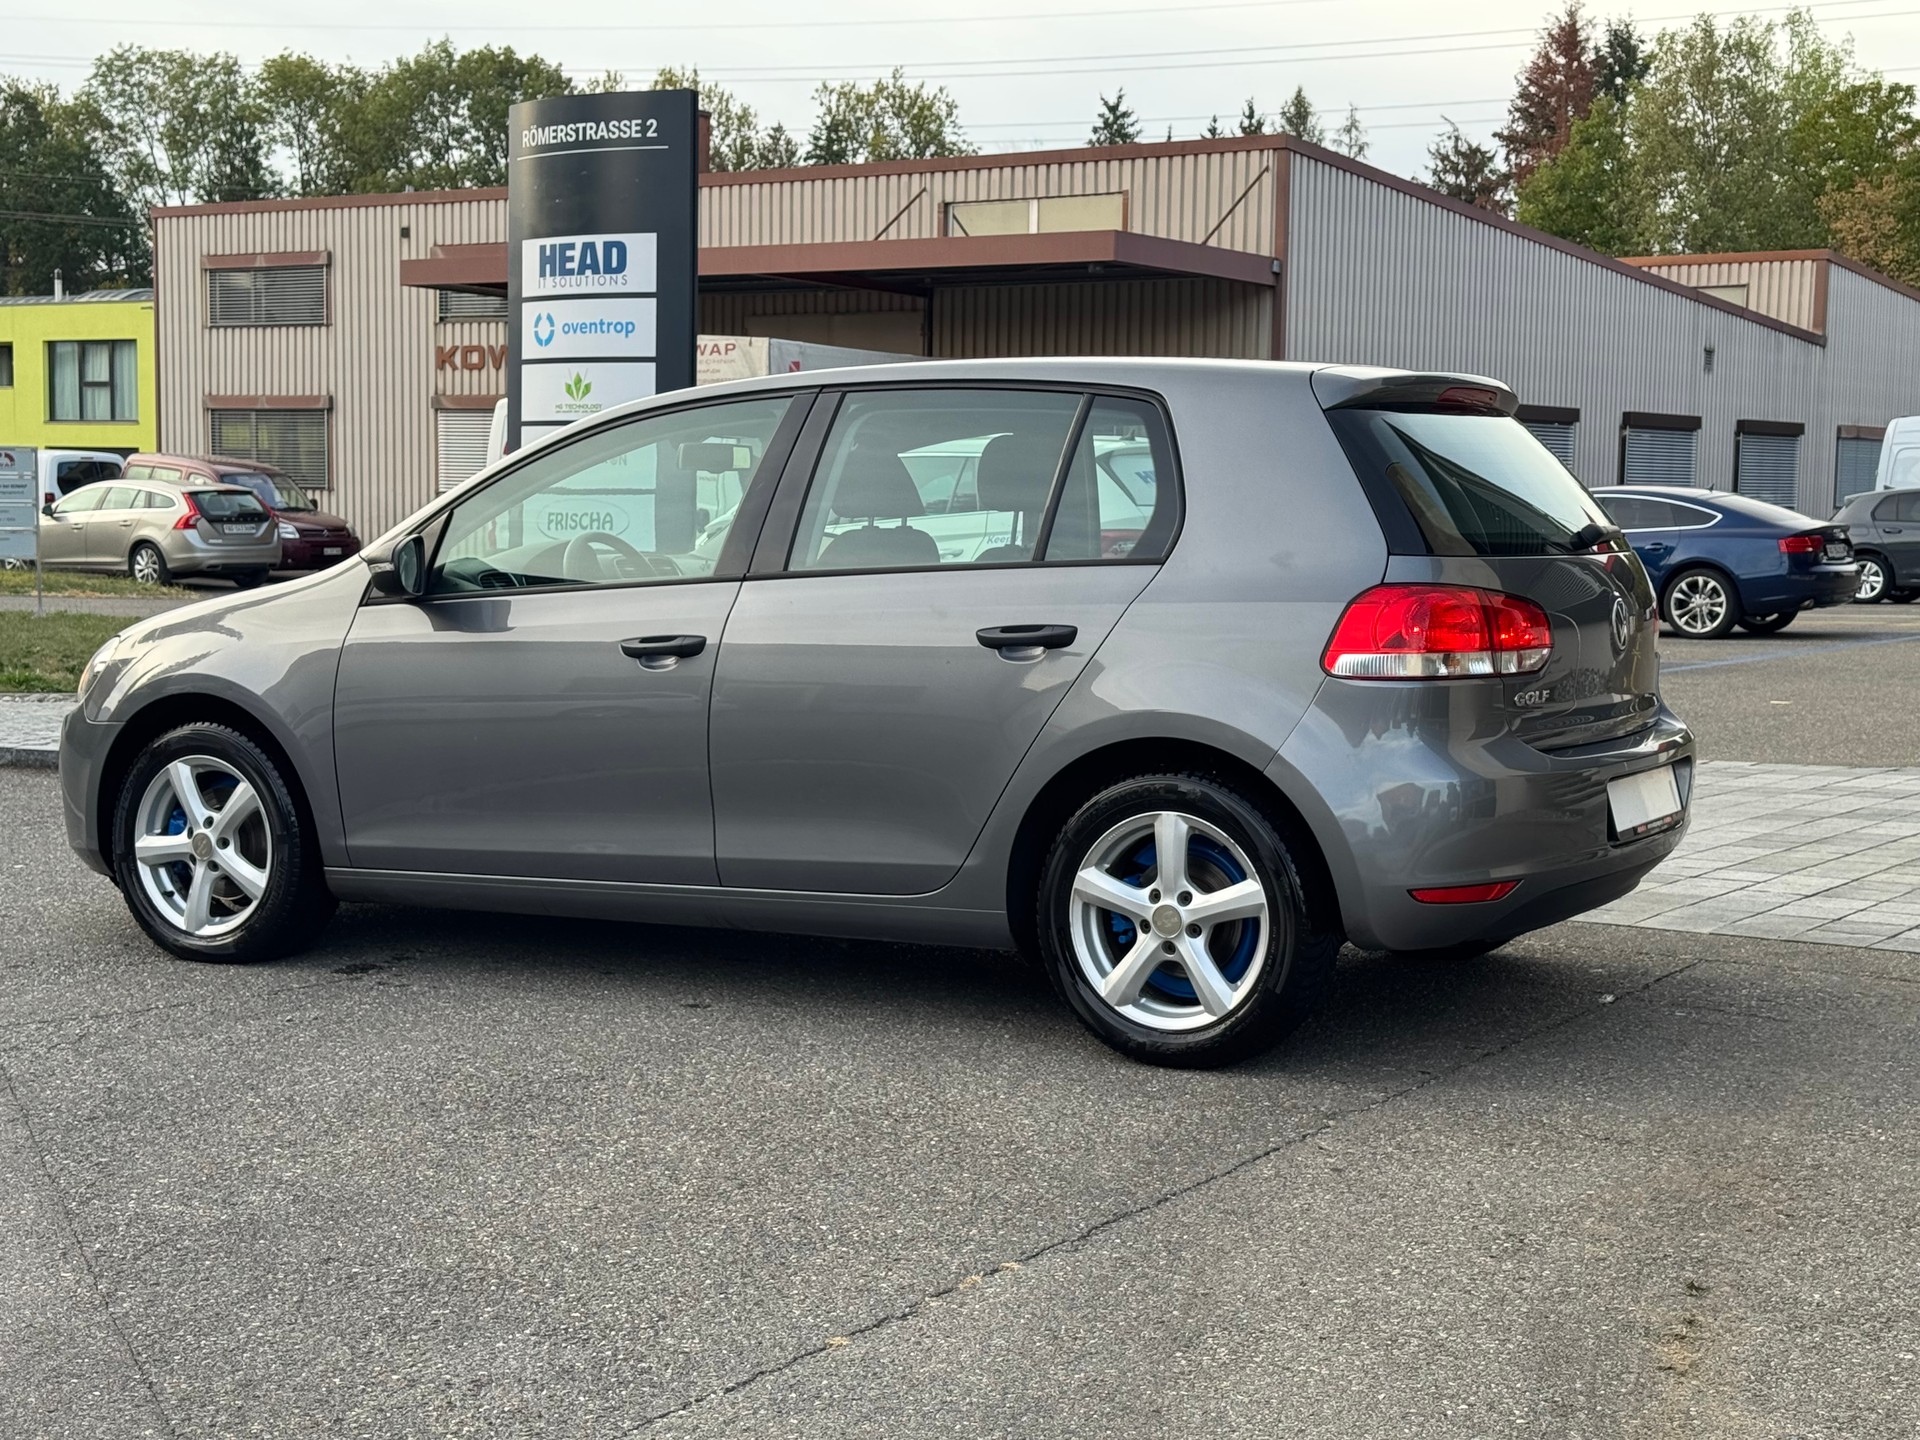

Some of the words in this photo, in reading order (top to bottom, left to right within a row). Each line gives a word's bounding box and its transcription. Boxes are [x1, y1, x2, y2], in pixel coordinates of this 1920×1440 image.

[522, 119, 642, 148] RÖMERSTRASSE
[645, 118, 658, 138] 2
[539, 240, 628, 278] HEAD
[538, 277, 547, 289] IT
[552, 274, 628, 288] SOLUTIONS
[562, 318, 636, 338] oventrop
[547, 511, 614, 532] FRISCHA
[1514, 689, 1551, 707] GOLF
